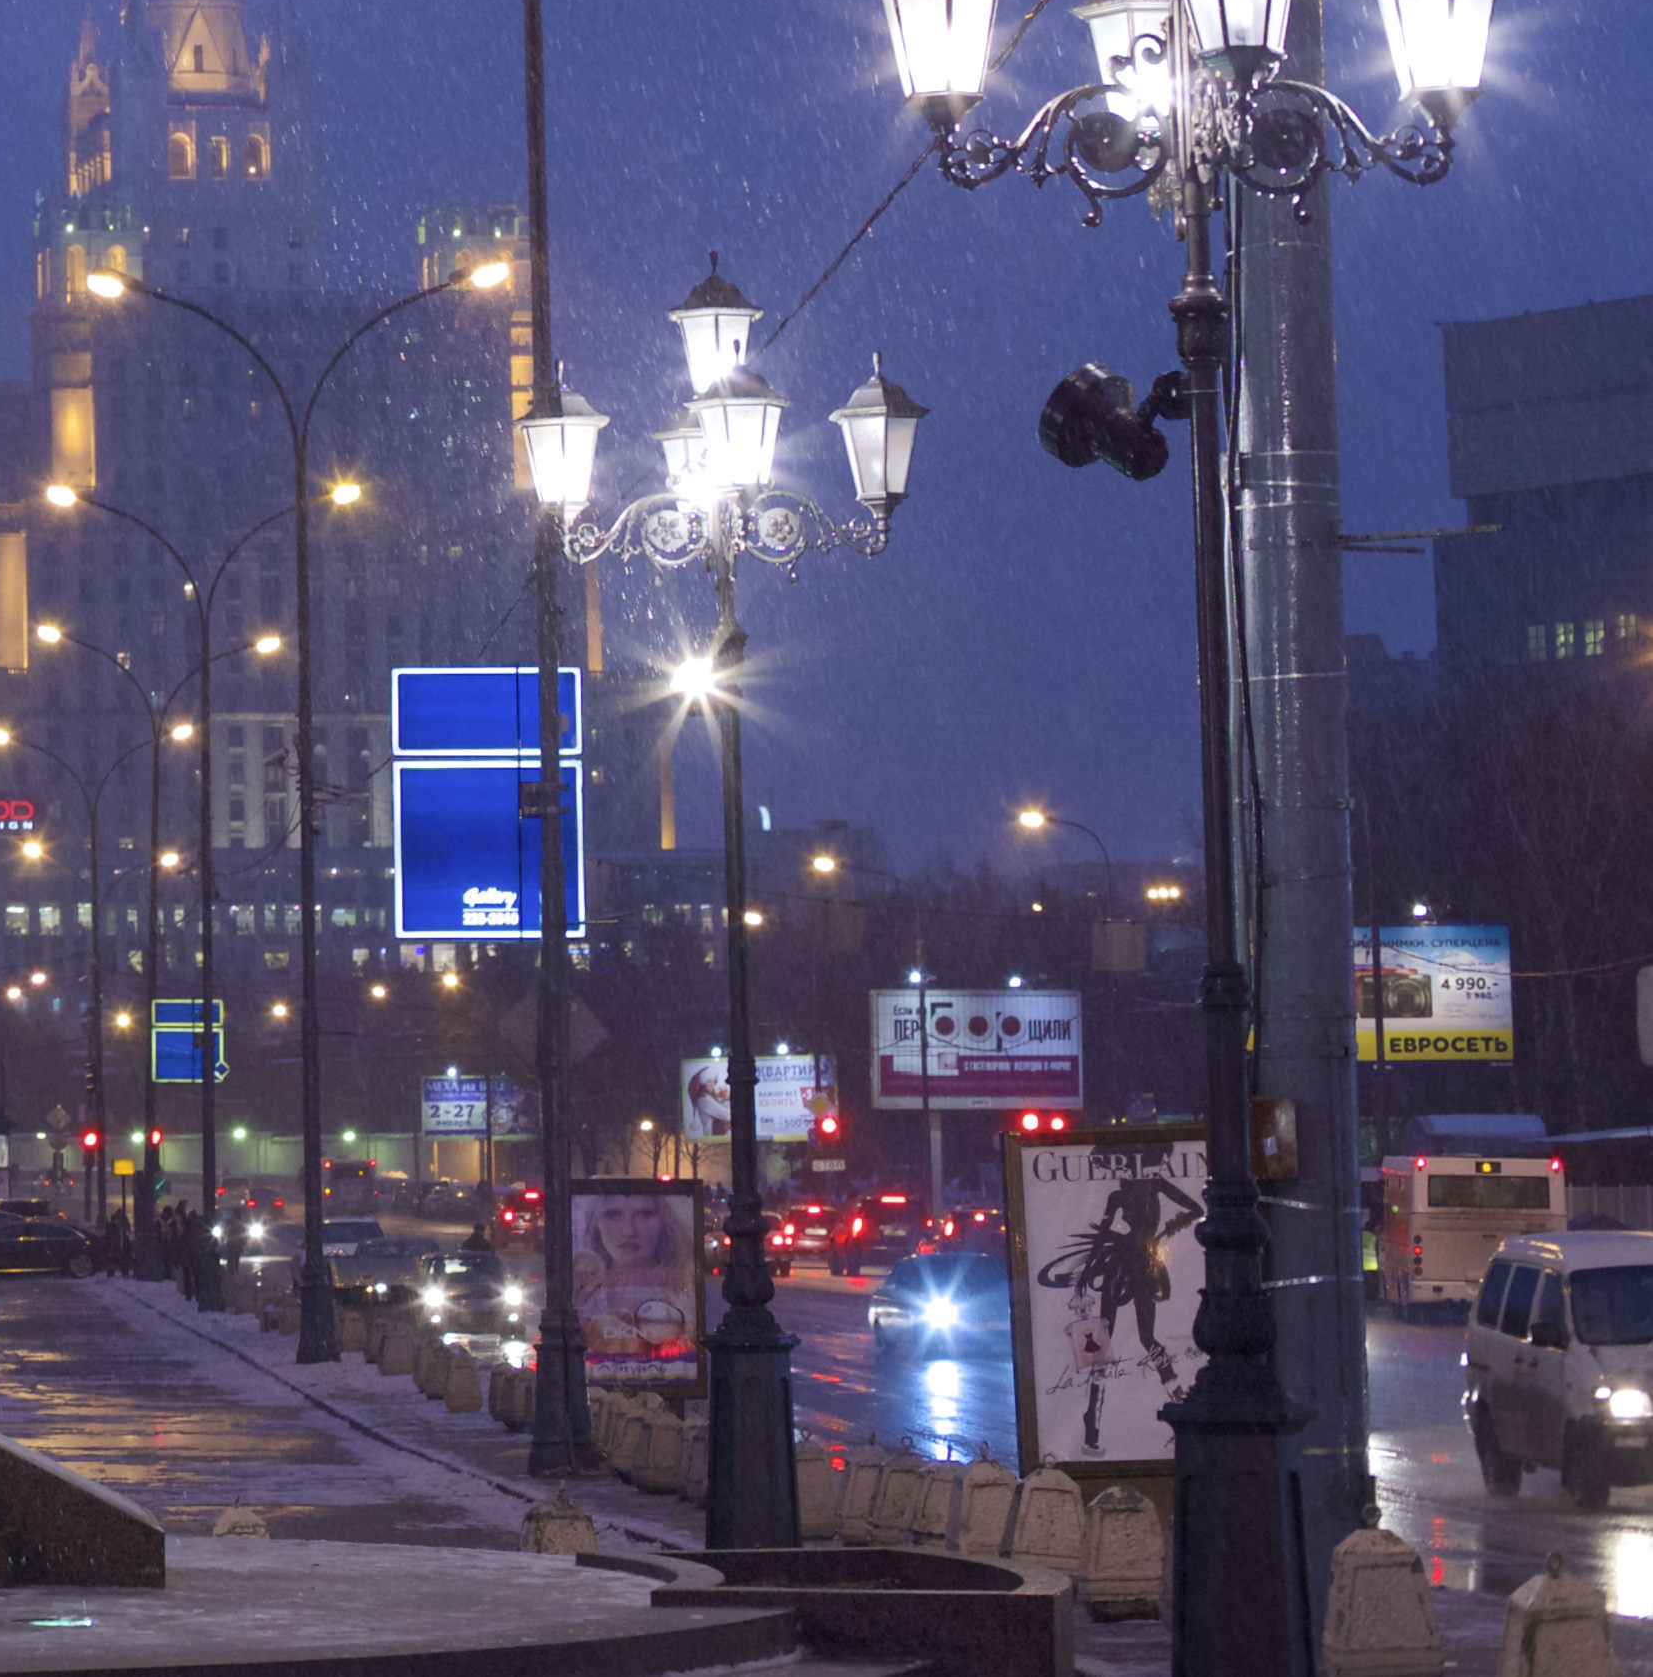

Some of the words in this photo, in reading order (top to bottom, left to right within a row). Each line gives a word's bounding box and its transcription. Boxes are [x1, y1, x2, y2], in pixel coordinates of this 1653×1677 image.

[1430, 938, 1502, 949] СУПЕРЦЕНА
[1389, 1036, 1509, 1054] ЕВРОСЕТЬ
[755, 1065, 816, 1078] КВАРТИР
[453, 1105, 475, 1118] 27
